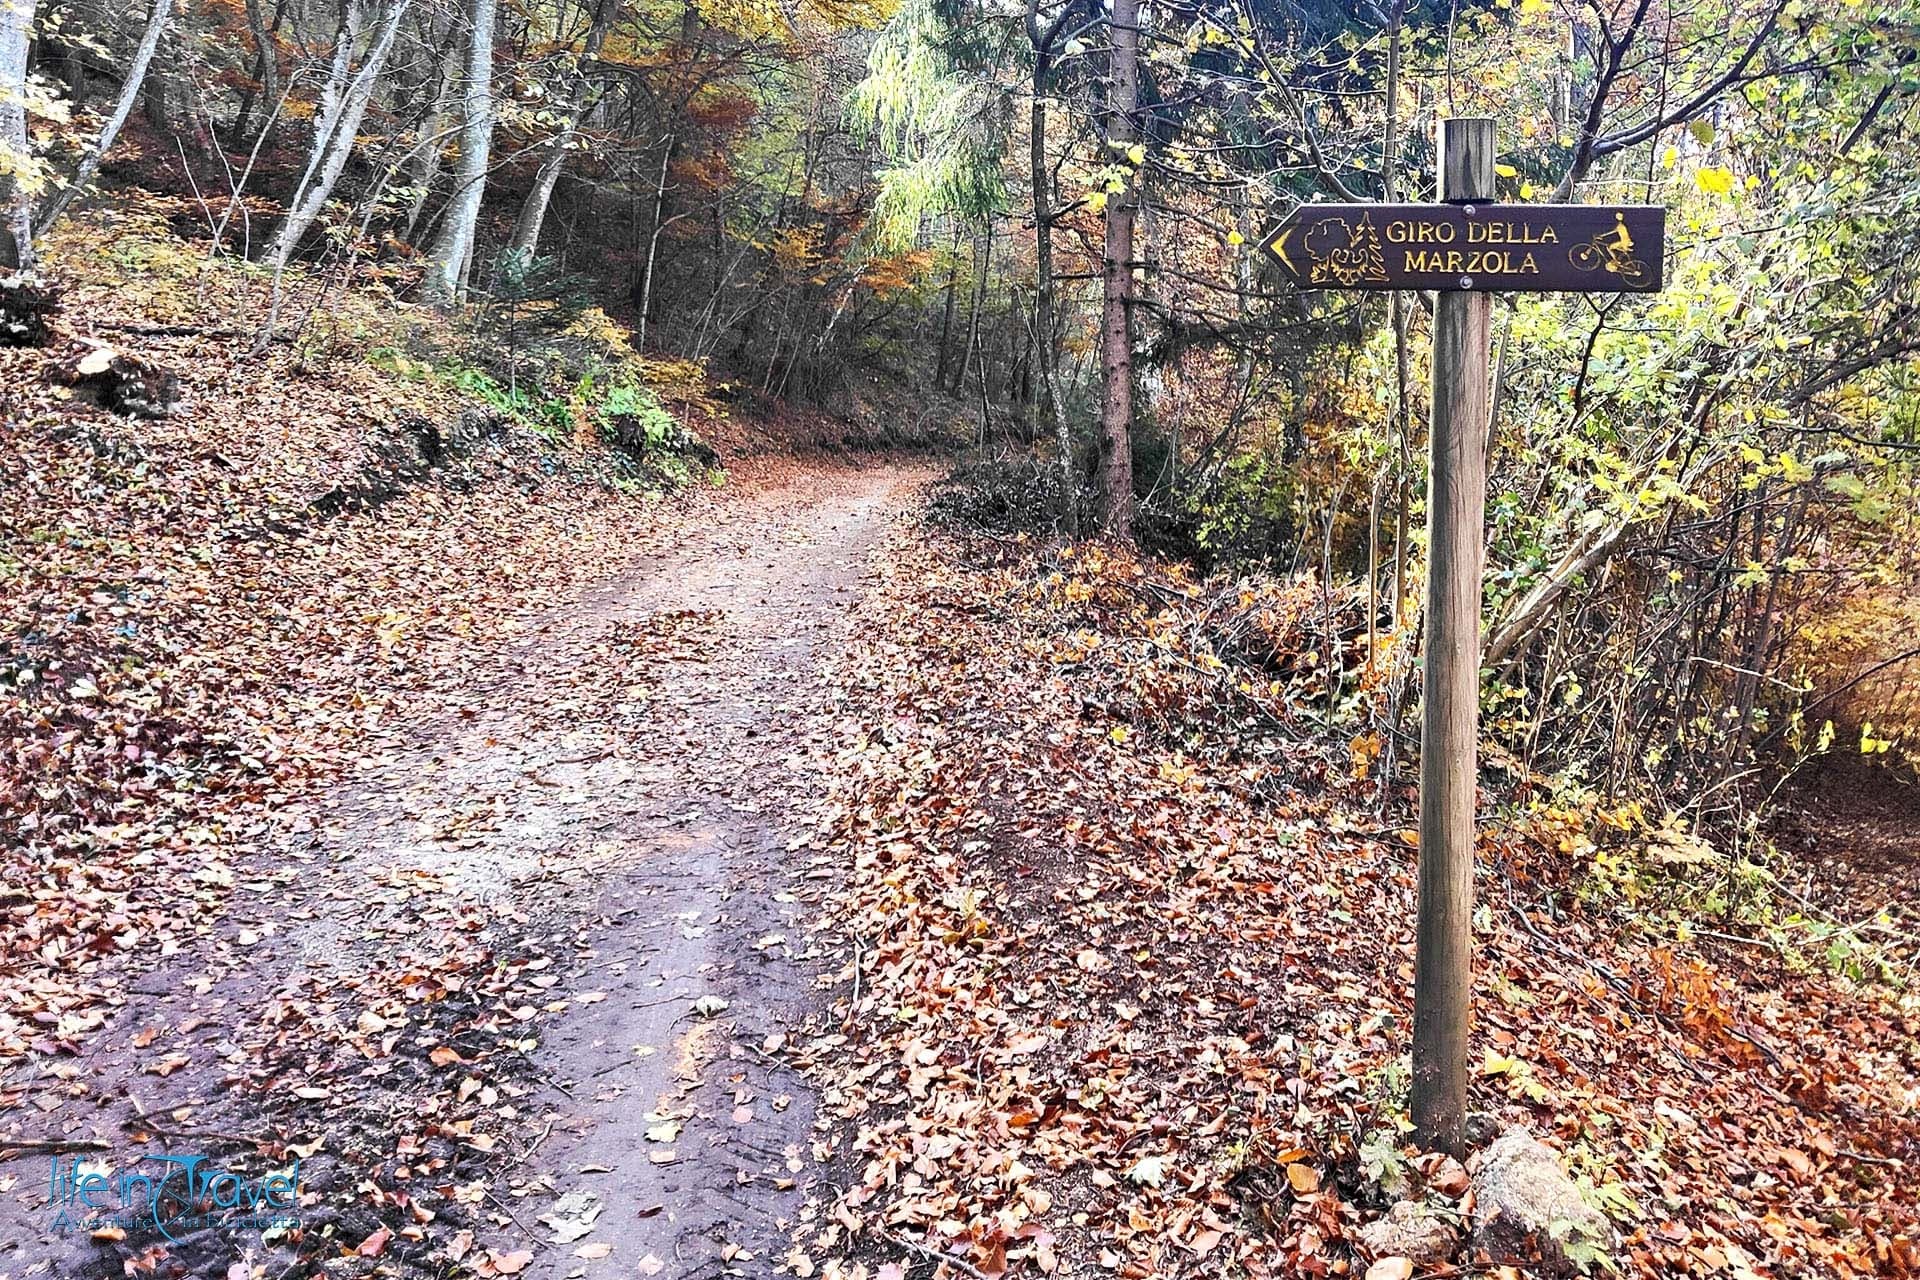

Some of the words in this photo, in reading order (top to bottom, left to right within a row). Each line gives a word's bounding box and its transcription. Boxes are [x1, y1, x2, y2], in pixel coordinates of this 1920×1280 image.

[1386, 221, 1456, 243] GIRO
[1467, 221, 1559, 244] DELLA
[1404, 250, 1539, 274] MARZOLA
